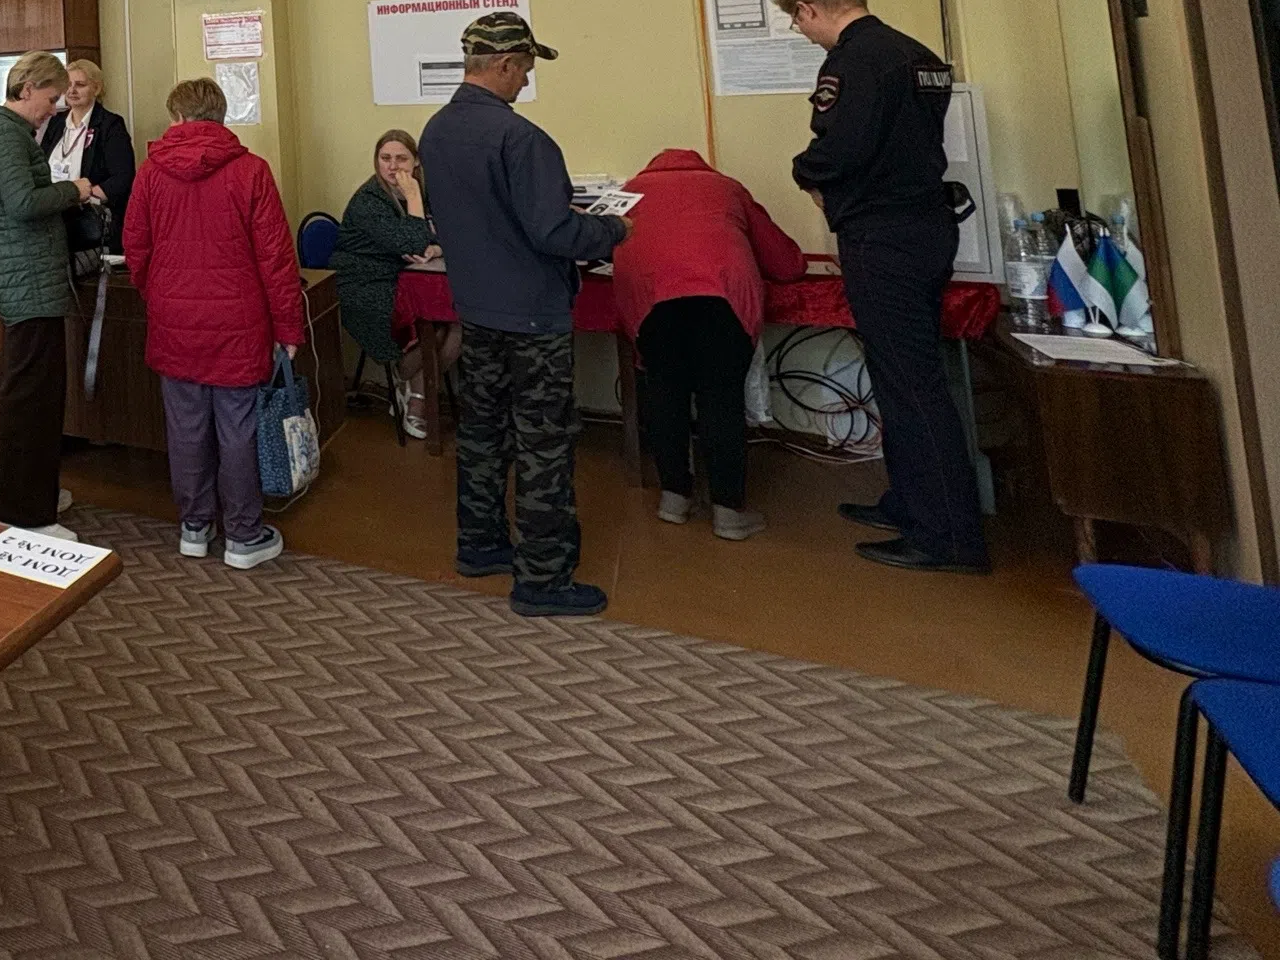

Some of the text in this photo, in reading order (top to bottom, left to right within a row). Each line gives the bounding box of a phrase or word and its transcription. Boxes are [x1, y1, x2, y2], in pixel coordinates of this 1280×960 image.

[2, 536, 16, 545] 2
[40, 546, 96, 565] ДОМ
[21, 558, 80, 578] ДОМ
